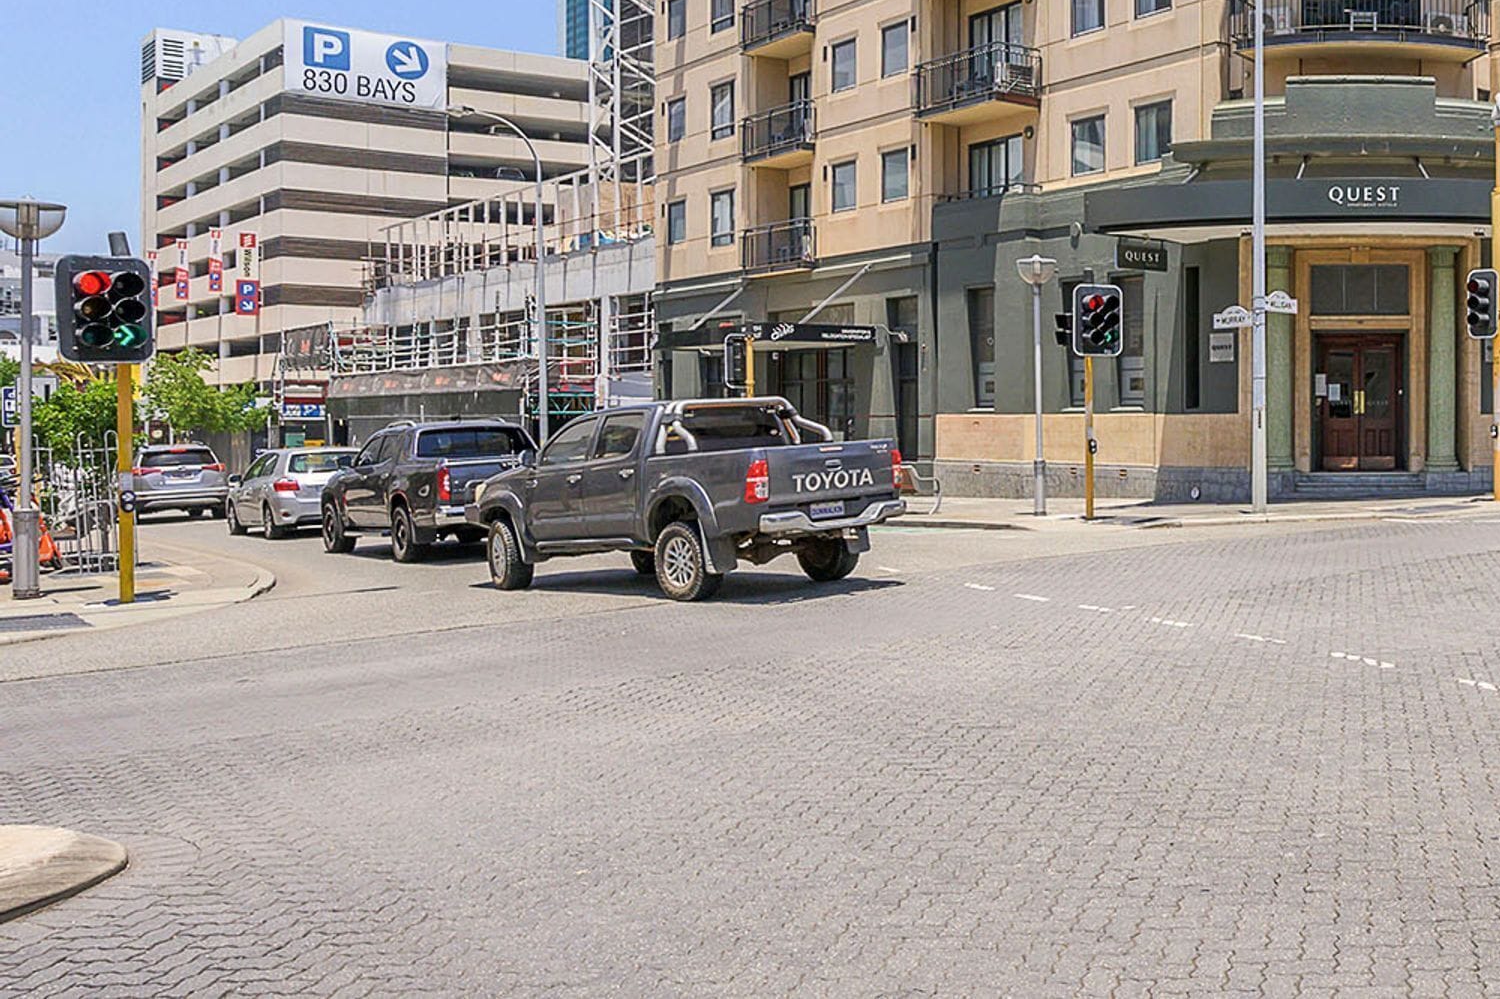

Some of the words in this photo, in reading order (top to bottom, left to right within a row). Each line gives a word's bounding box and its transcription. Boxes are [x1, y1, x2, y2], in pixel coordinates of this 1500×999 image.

[313, 32, 343, 64] P
[302, 68, 348, 95] 830
[356, 74, 416, 105] BAYS
[1327, 185, 1401, 205] QUEST
[1125, 250, 1160, 263] QUEST
[242, 283, 254, 295] P
[791, 467, 875, 494] TOYOTA
